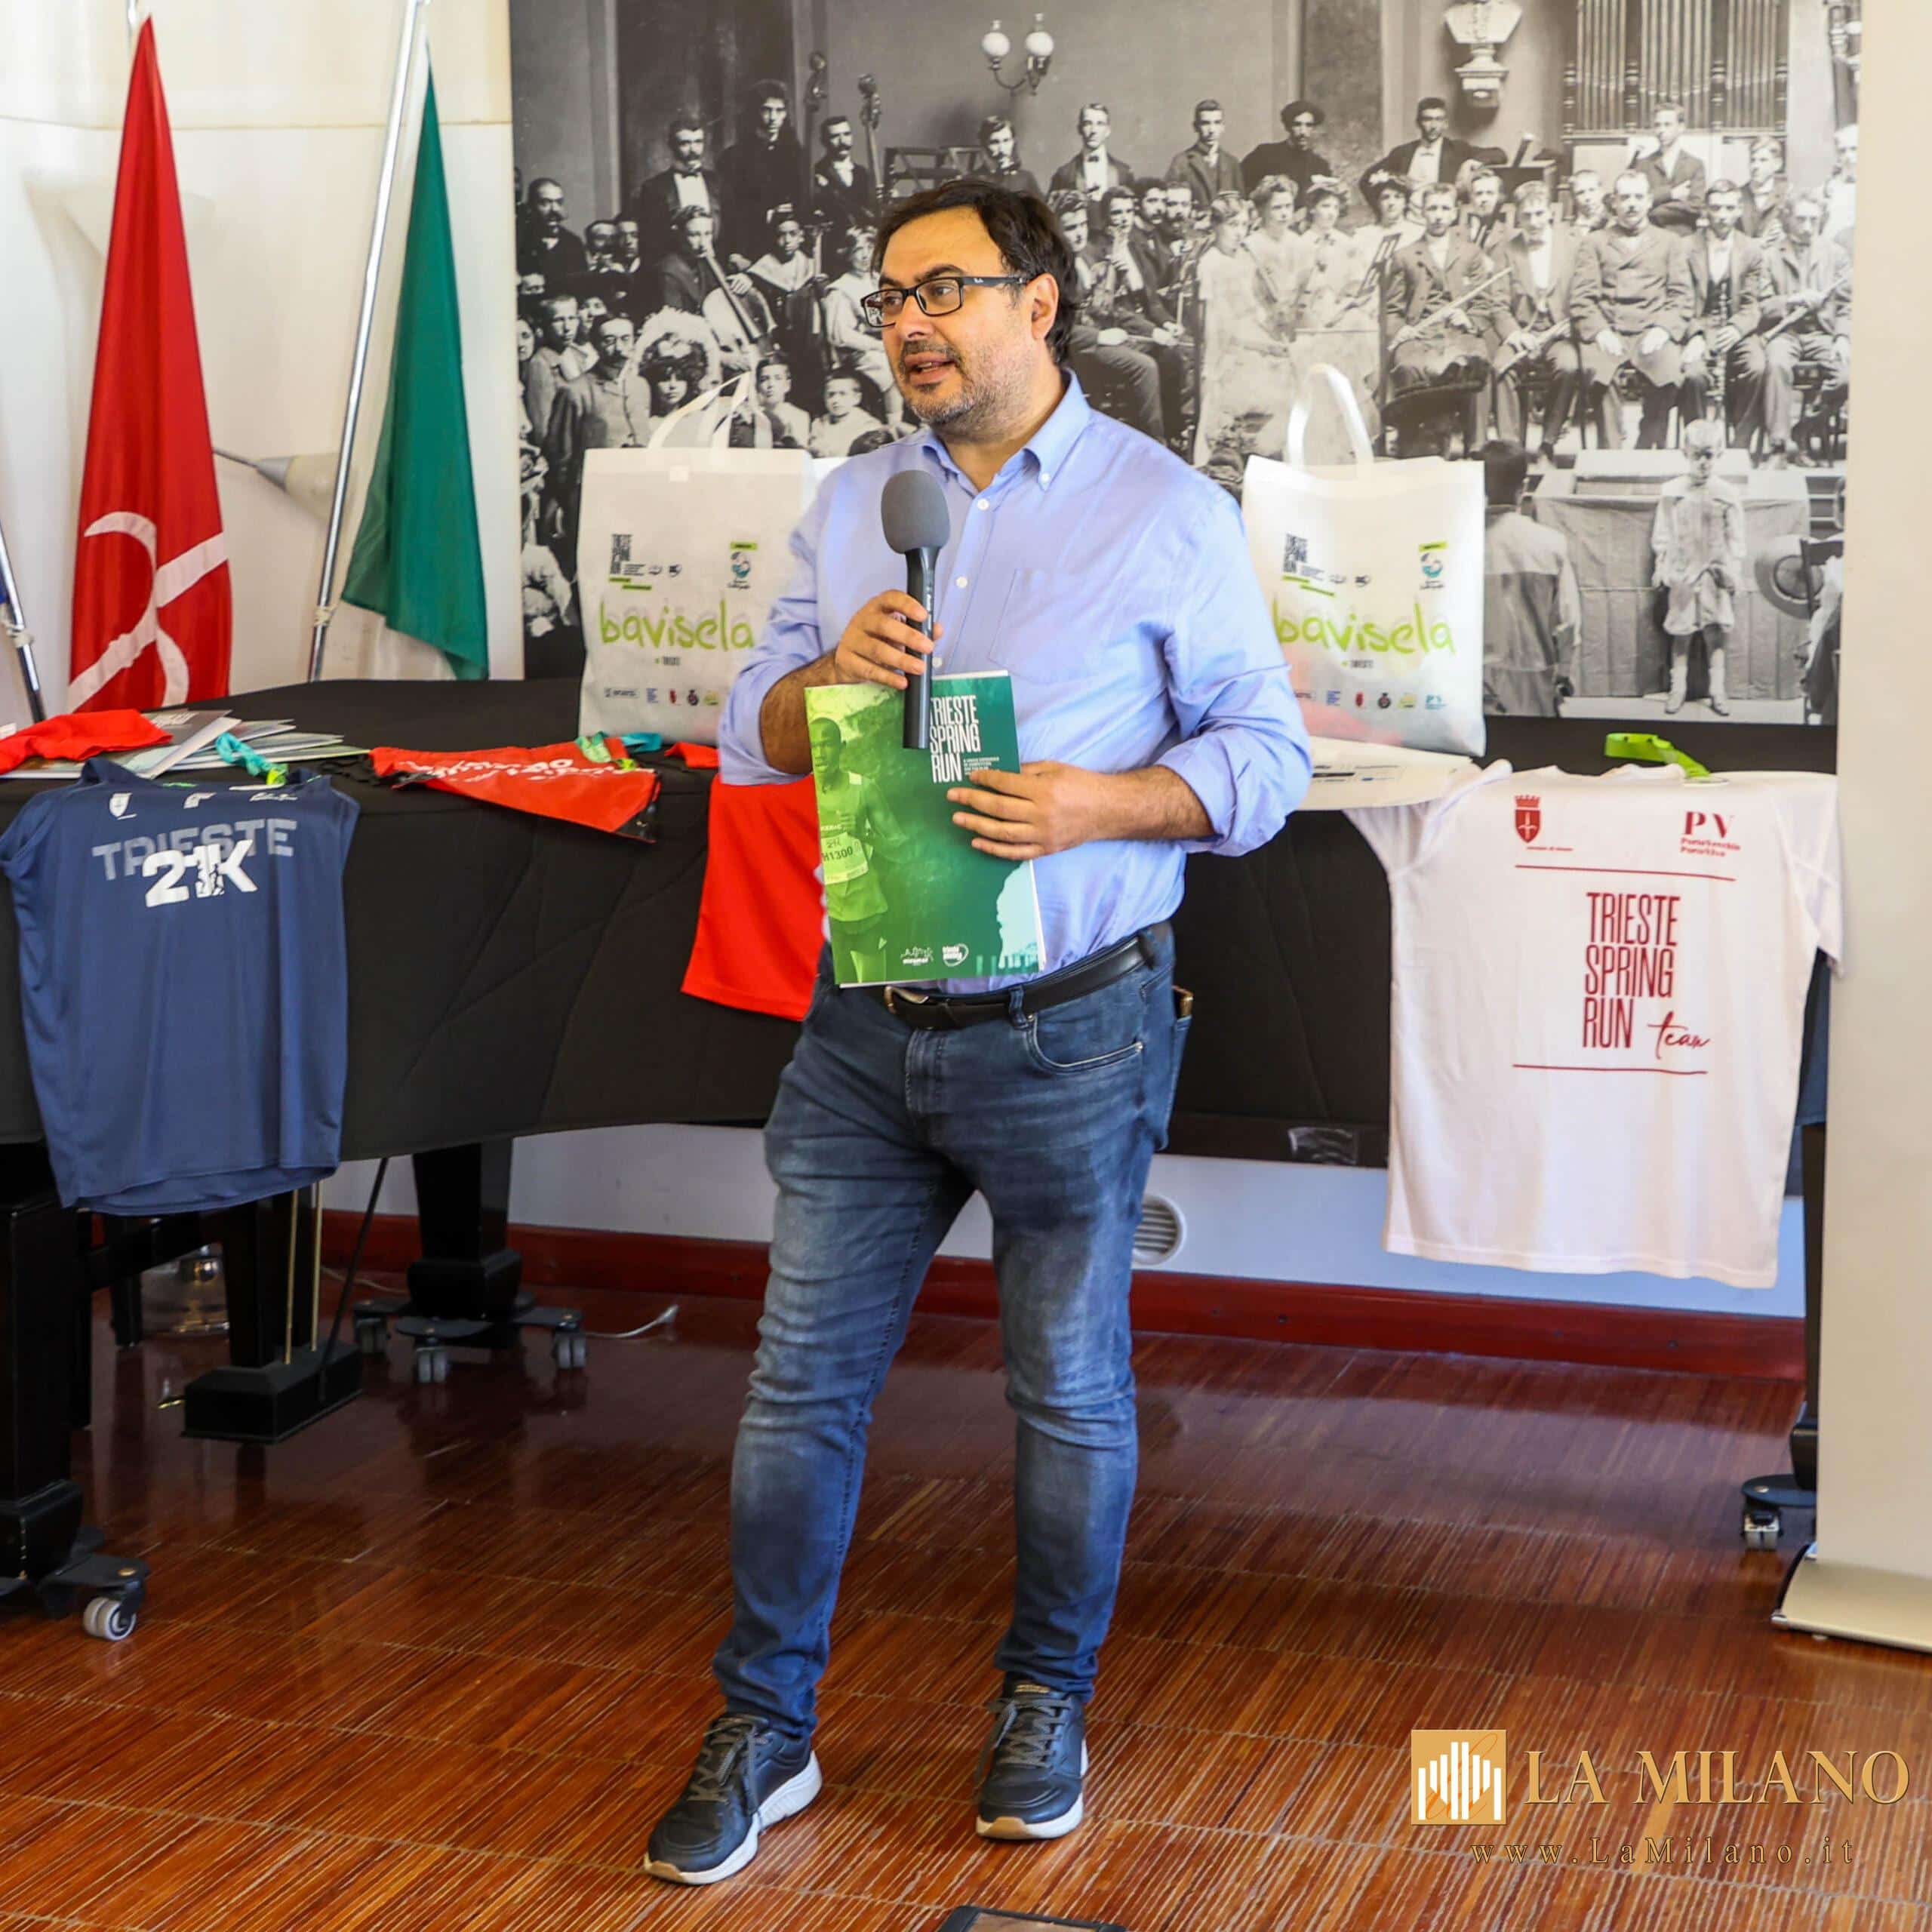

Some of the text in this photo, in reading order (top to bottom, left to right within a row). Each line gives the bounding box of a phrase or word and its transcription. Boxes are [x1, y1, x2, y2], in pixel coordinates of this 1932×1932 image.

[599, 597, 754, 651] bavisela
[1272, 598, 1456, 655] bavisela
[929, 724, 981, 753] SPRING
[931, 752, 963, 783] RUN
[91, 818, 298, 881] TRIESTE
[141, 838, 259, 908] 21K
[1586, 891, 1681, 947] TRIESTE
[1584, 944, 1675, 998] SPRING
[1582, 996, 1711, 1060] RUN team
